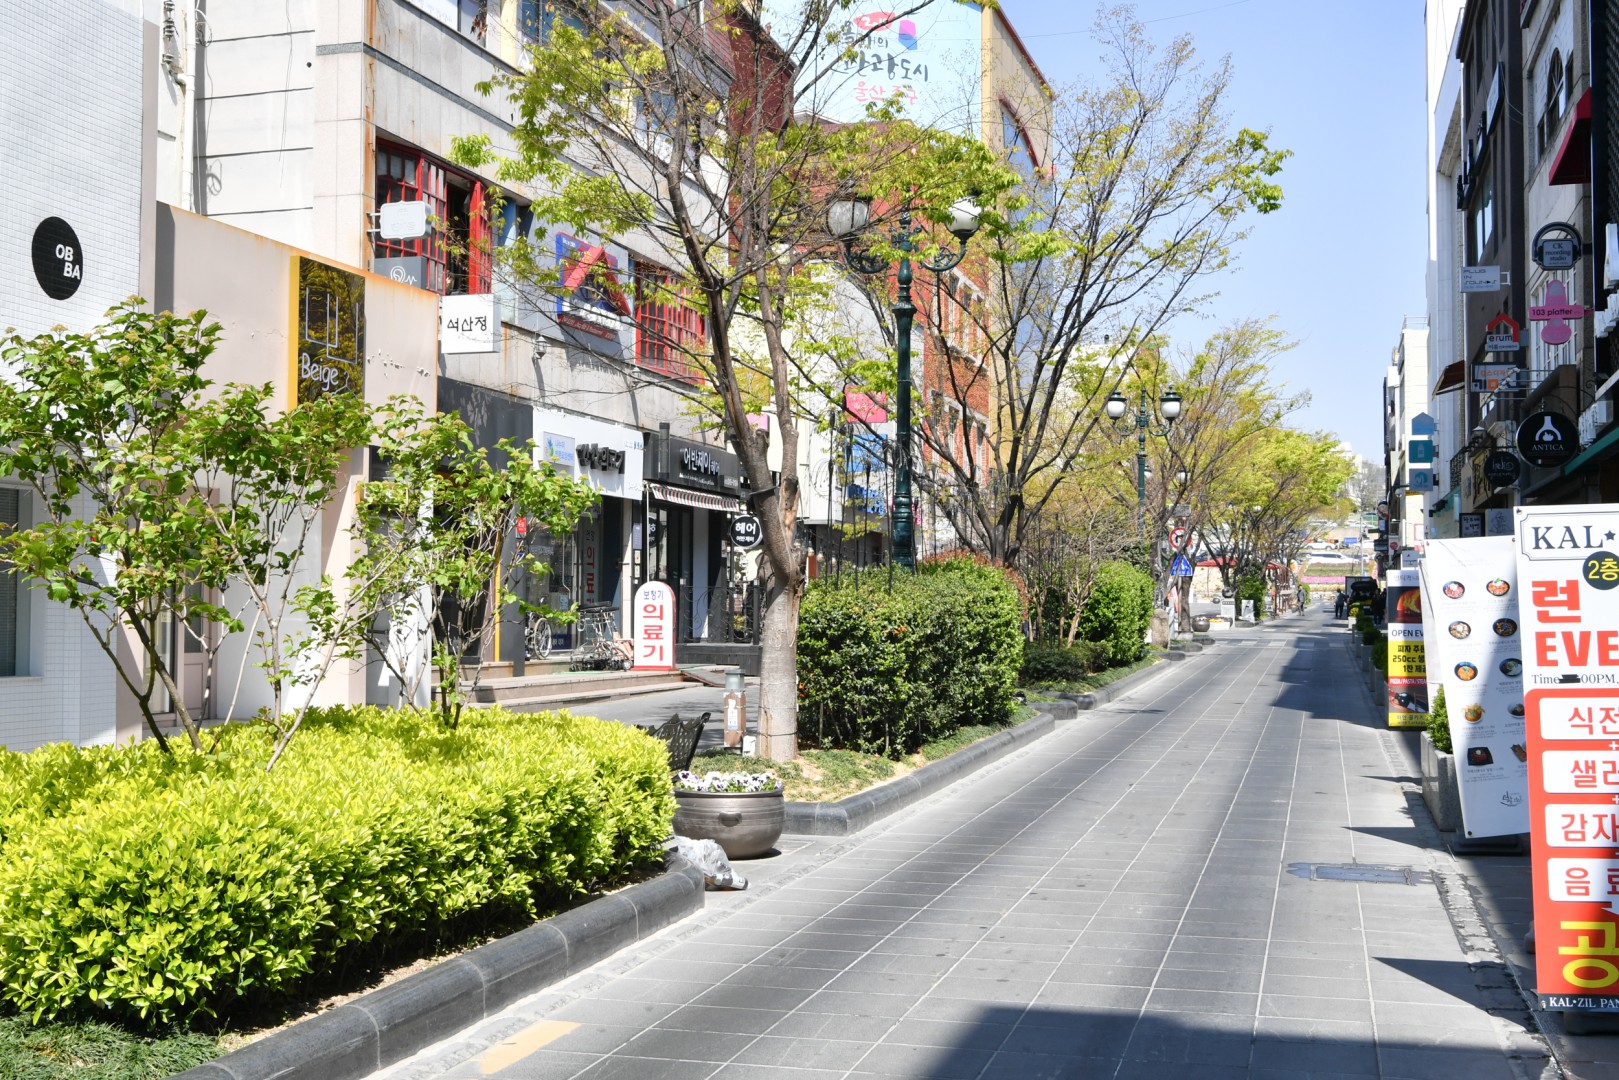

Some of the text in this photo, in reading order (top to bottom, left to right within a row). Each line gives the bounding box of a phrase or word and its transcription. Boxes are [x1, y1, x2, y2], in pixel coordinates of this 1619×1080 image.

[55, 243, 74, 262] OB
[63, 262, 81, 280] BA
[1547, 308, 1573, 317] platter
[446, 315, 488, 333] 석산정
[1488, 334, 1513, 342] erum
[301, 352, 339, 391] Beige
[735, 522, 757, 535] 헤어
[1531, 525, 1604, 550] KAL
[1588, 558, 1619, 581] 2층
[642, 590, 665, 601] 보청기
[1531, 579, 1582, 624] 런
[641, 603, 665, 663] 의료기
[1391, 629, 1413, 638] OPEN
[1535, 630, 1619, 667] EVE
[1392, 655, 1416, 663] 250cc
[1531, 673, 1560, 685] Time
[1560, 813, 1619, 843] 감자
